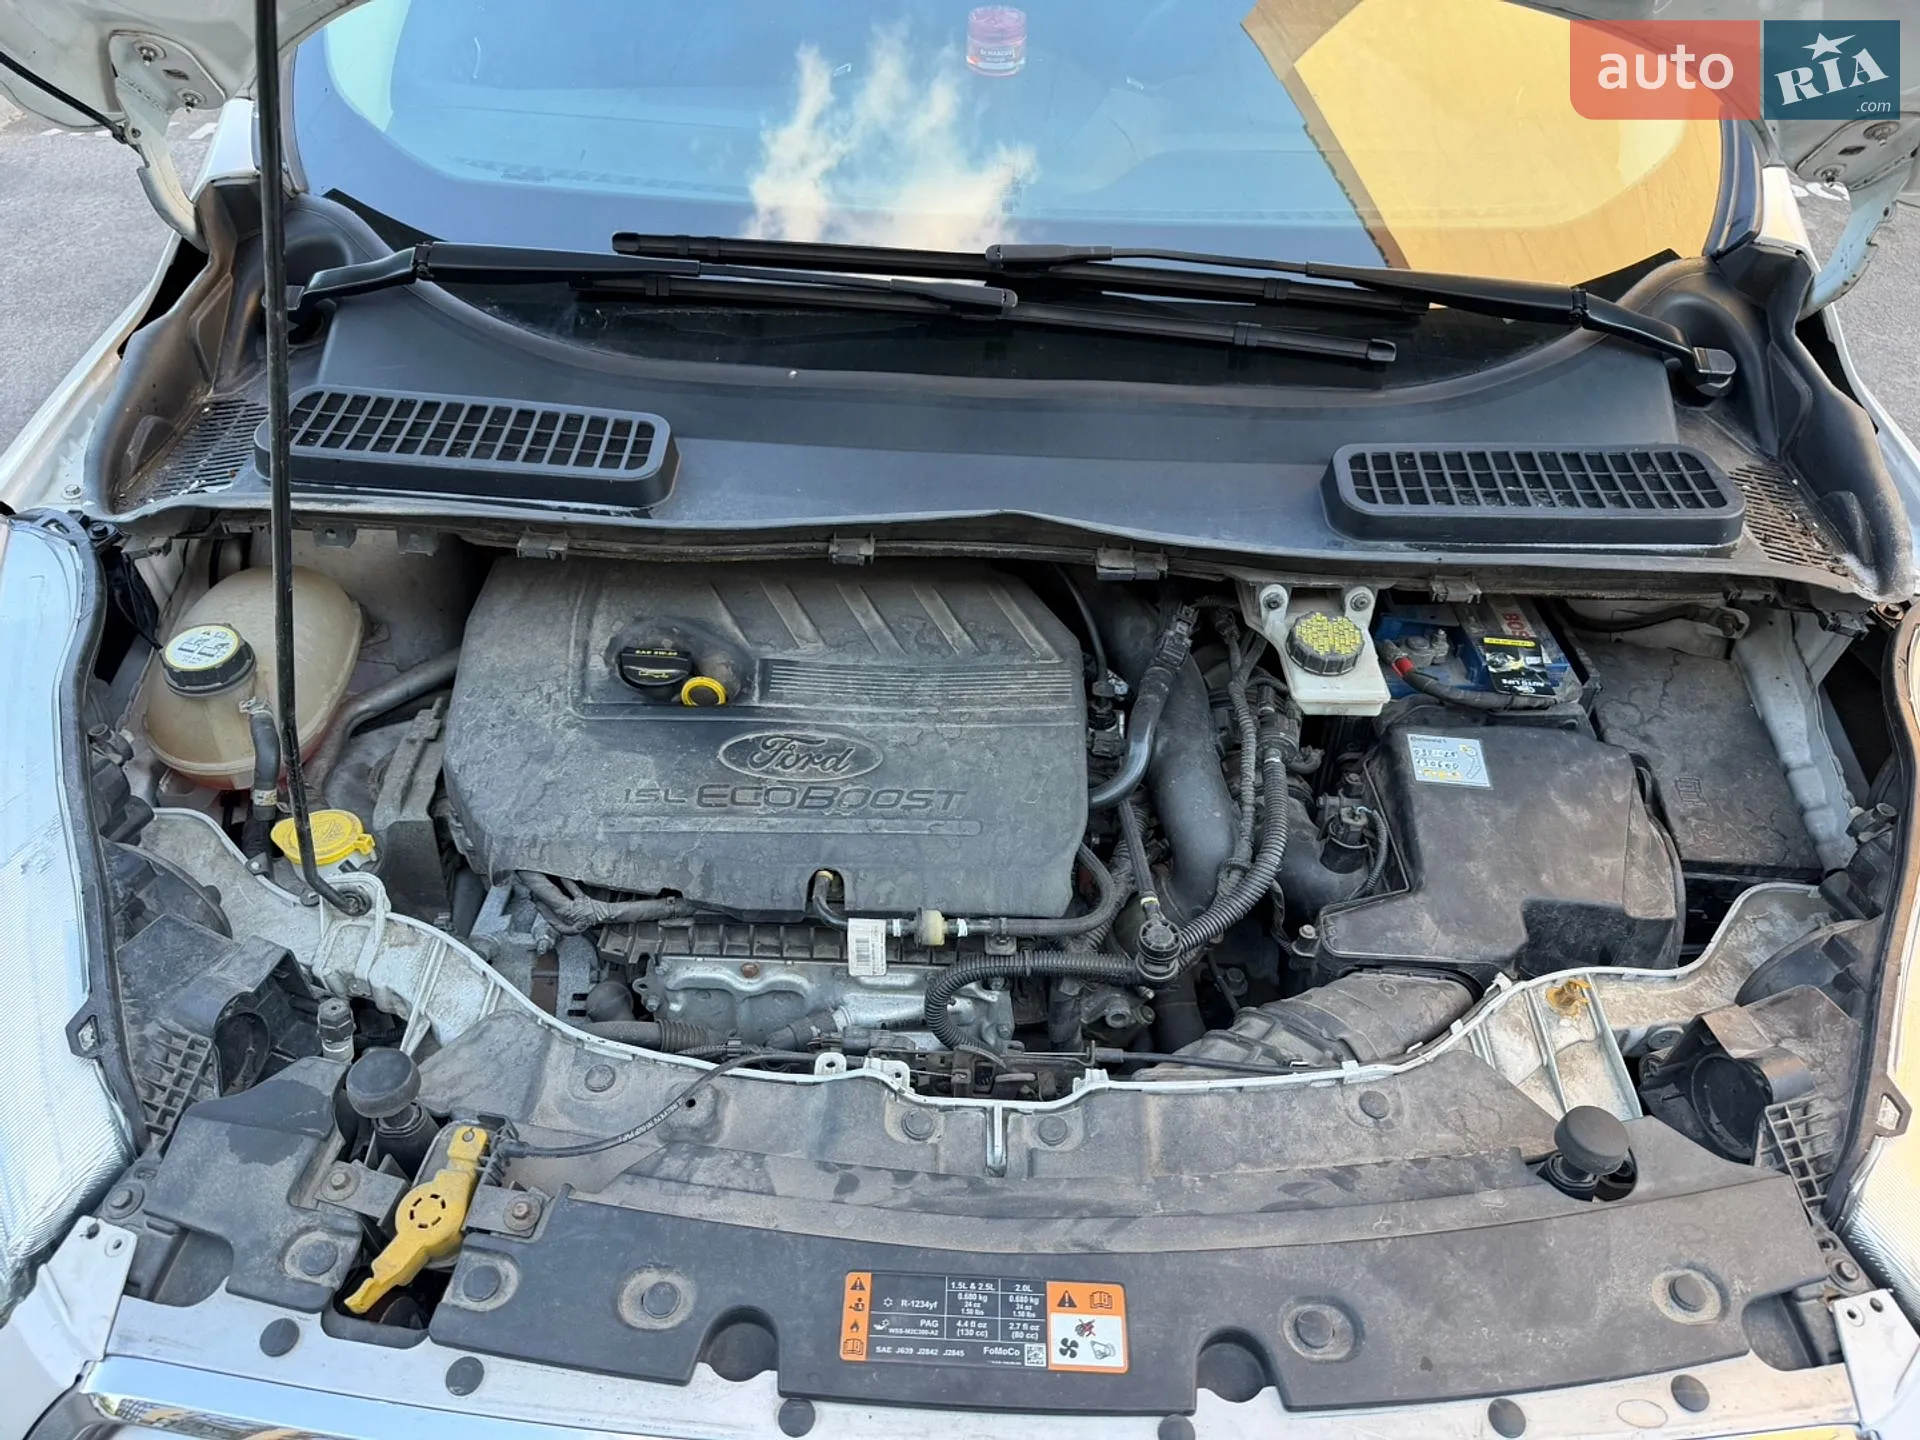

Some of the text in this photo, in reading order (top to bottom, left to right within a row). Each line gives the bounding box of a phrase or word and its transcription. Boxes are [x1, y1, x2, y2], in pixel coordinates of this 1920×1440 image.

[750, 734, 853, 775] Ford
[697, 784, 968, 811] ECOBOOST
[951, 1281, 995, 1291] 1.5L & 2.5L
[1015, 1284, 1033, 1292] 2.0L
[978, 1293, 988, 1303] kg
[1029, 1296, 1039, 1305] kg
[901, 1299, 938, 1311] R-1234yf
[920, 1319, 939, 1328] PAG
[956, 1319, 969, 1328] 4.4
[1009, 1322, 1021, 1331] 2.7
[957, 1328, 988, 1338] (130 cc)
[1011, 1331, 1039, 1341] (80 cc)
[875, 1346, 893, 1354] SAE
[895, 1347, 914, 1355] J639
[983, 1346, 1020, 1356] FoMoCo
